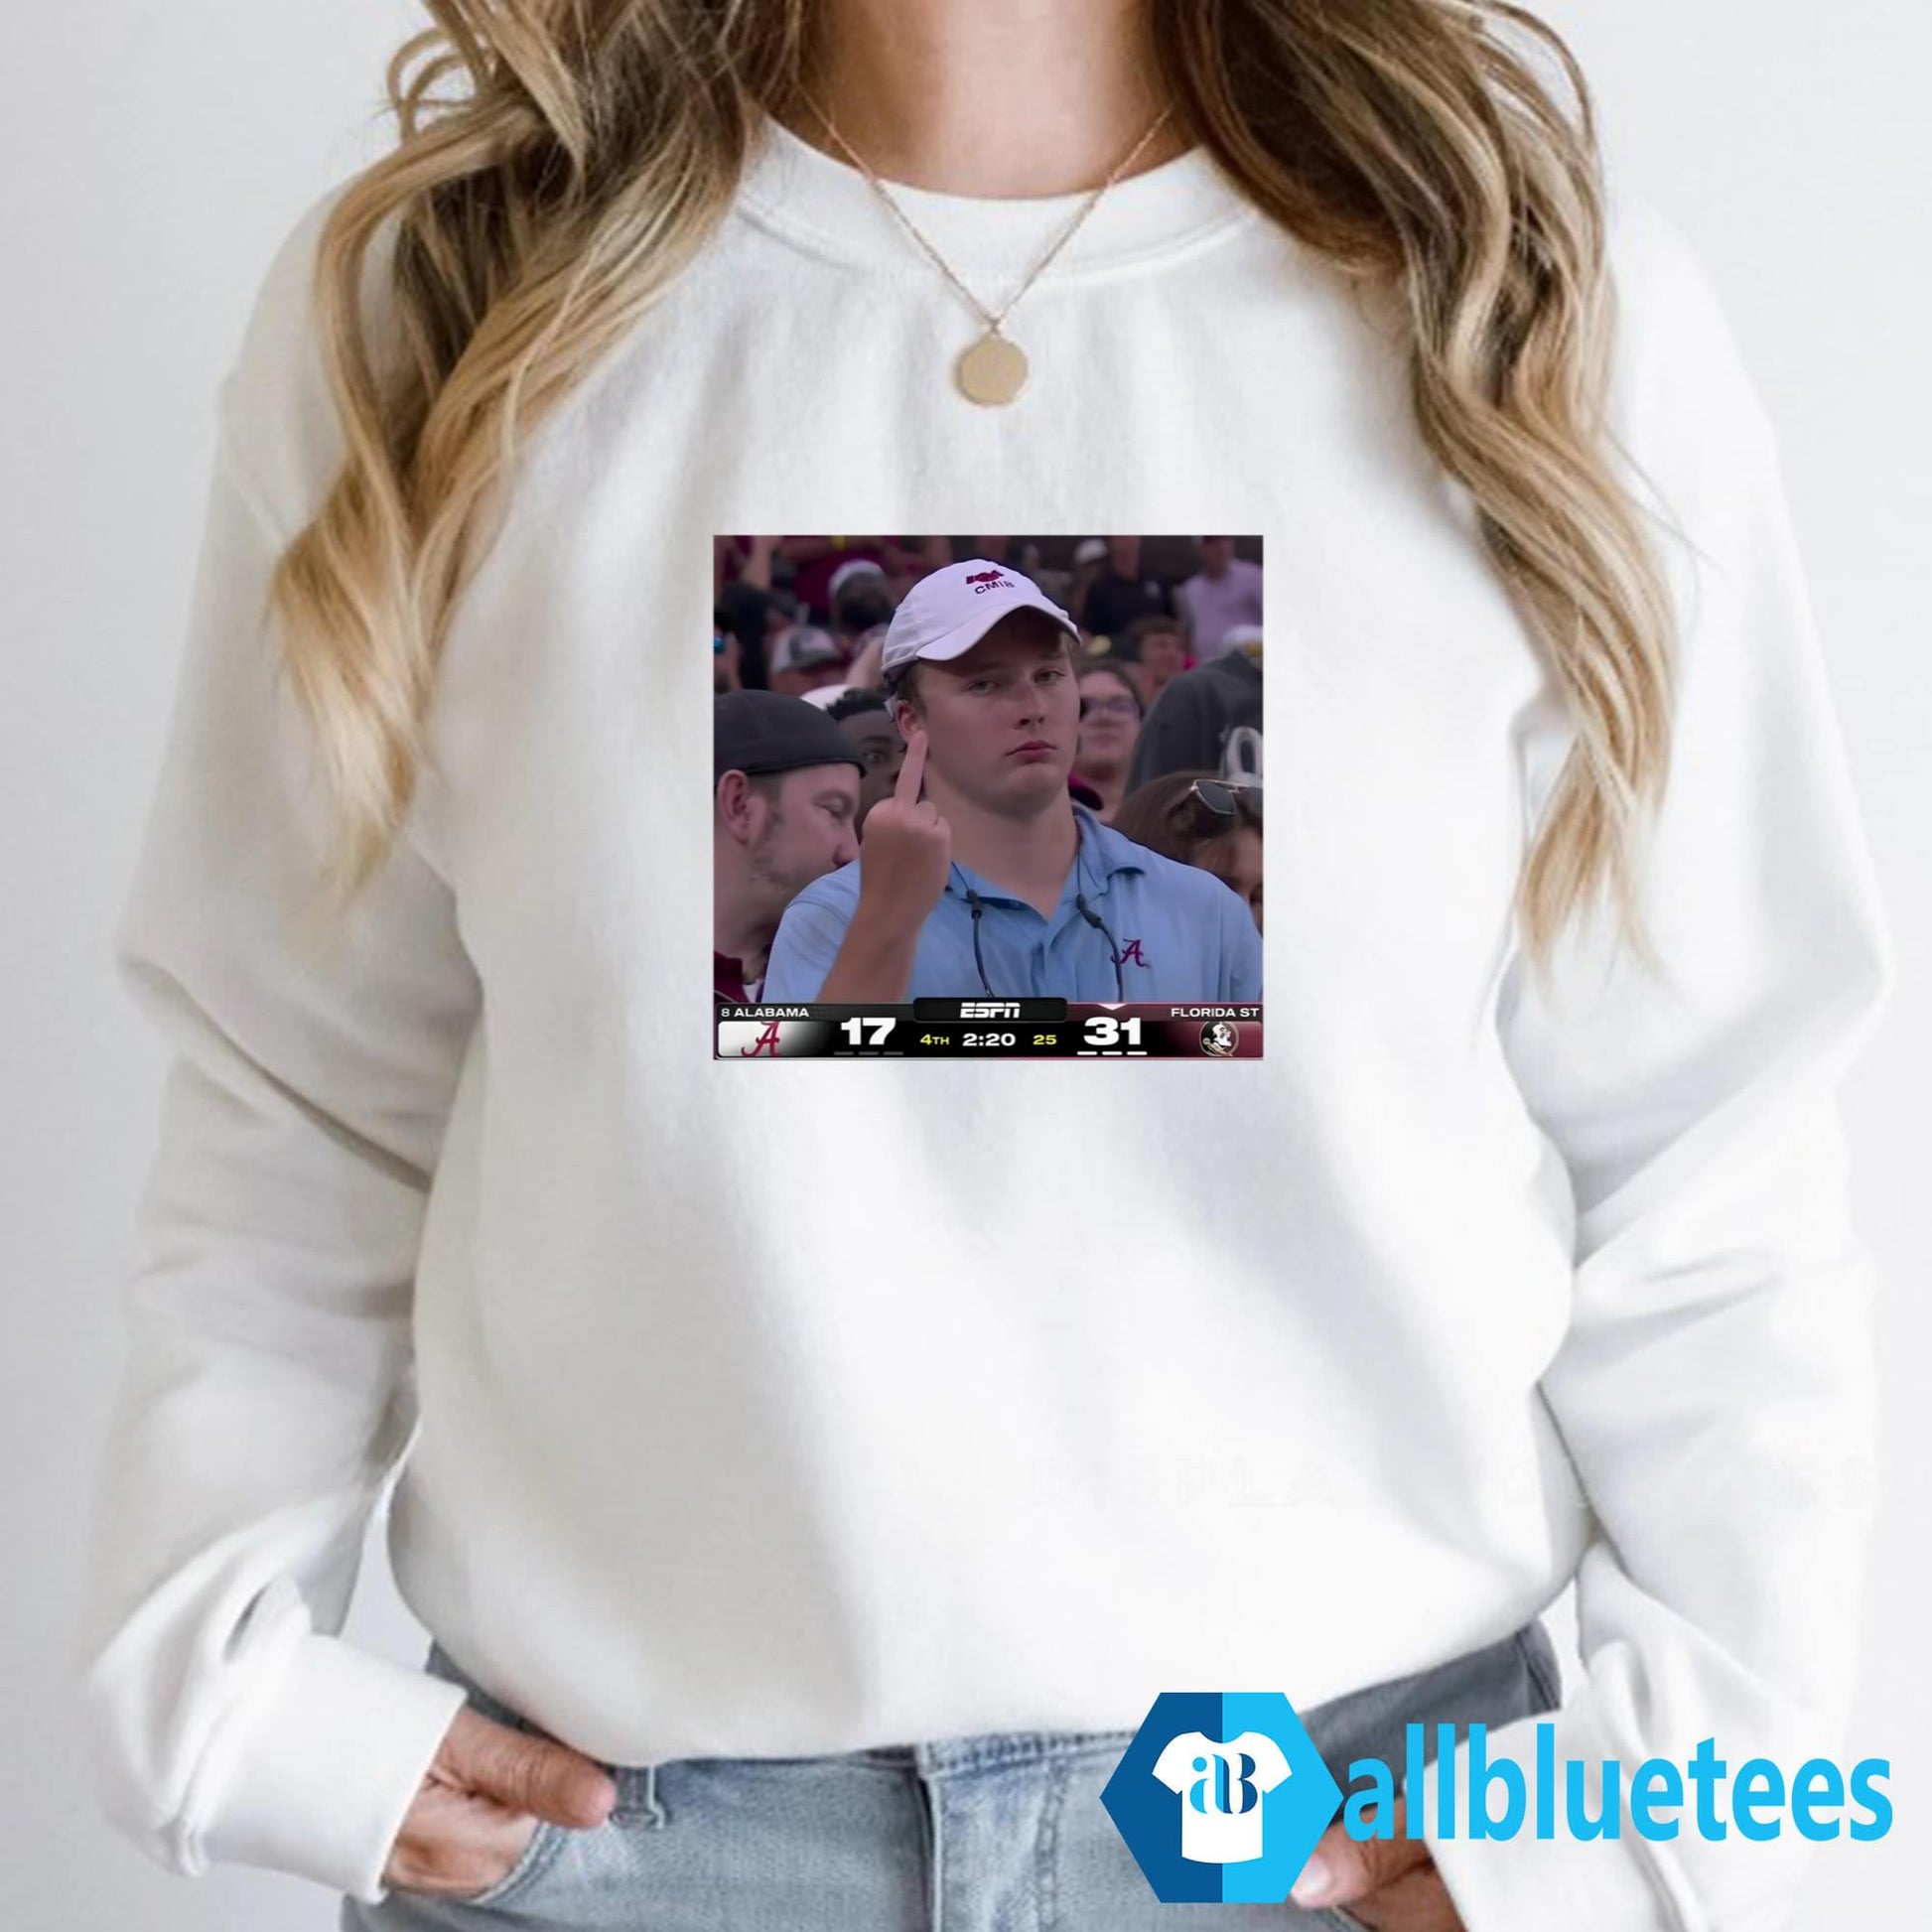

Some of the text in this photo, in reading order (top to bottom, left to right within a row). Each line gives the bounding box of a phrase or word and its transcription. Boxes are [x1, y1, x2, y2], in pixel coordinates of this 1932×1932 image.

[721, 1008, 809, 1018] 8 ALABAMA
[960, 1002, 1021, 1019] ESPN
[1171, 1008, 1260, 1018] FLORIDA ST
[841, 1017, 897, 1045] 17
[1083, 1017, 1142, 1045] 31
[919, 1034, 1057, 1046] 4TH 2:20 25
